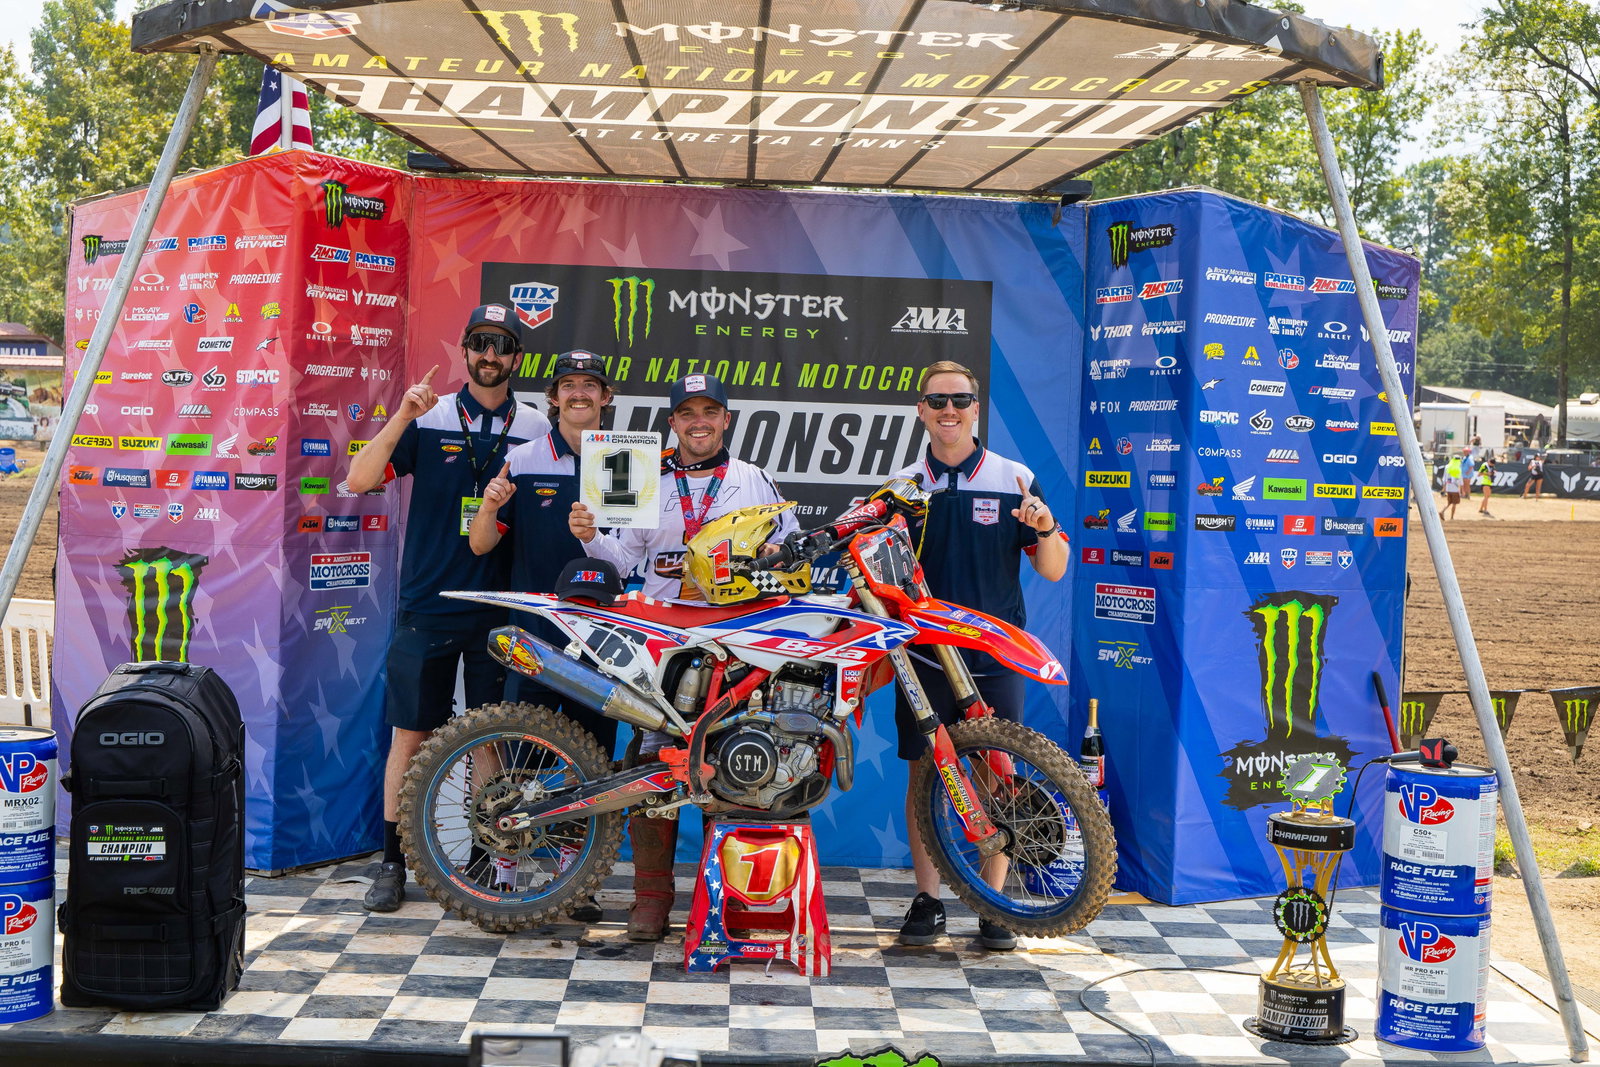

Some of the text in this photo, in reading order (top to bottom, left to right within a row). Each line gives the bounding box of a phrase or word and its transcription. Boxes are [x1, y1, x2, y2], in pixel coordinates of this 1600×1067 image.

[612, 20, 1021, 50] MONSTER
[679, 45, 954, 60] ENERGY
[271, 53, 1272, 95] AMATEUR NATIONAL MOTOCROSS
[568, 127, 947, 151] AT LORETTA LYNN'S
[344, 195, 384, 213] MONSTER
[1130, 226, 1173, 242] MONSTER
[188, 236, 226, 246] PARTS
[1136, 240, 1165, 248] ENERGY
[312, 245, 350, 262] AMSOIL
[355, 253, 395, 267] PARTS
[229, 273, 282, 285] PROGRESSIVE
[1265, 273, 1305, 285] PARTS
[1096, 286, 1133, 298] PARTS
[1140, 280, 1183, 298] AMSOIL
[1265, 281, 1305, 291] UNLIMITED
[1311, 279, 1356, 294] AMSOIL
[511, 286, 557, 299] MX
[365, 293, 398, 307] THOR
[668, 286, 848, 321] MONSTER
[891, 306, 969, 331] AMA
[1204, 313, 1257, 328] PROGRESSIVE
[1278, 317, 1308, 328] campers
[695, 324, 820, 340] ENERGY
[1104, 324, 1133, 339] THOR
[1318, 332, 1351, 341] OAKLEY
[306, 334, 337, 342] OAKLEY
[199, 340, 231, 349] COMETIC
[121, 372, 153, 380] Surefoot
[305, 364, 355, 378] PROGRESSIVE
[372, 368, 392, 381] FOX
[645, 357, 781, 387] NATIONAL
[1250, 383, 1284, 394] COMETIC
[121, 407, 153, 416] OGIO
[1100, 401, 1120, 413] FOX
[1128, 400, 1179, 412] PROGRESSIVE
[234, 408, 279, 417] COMPASS
[1200, 410, 1239, 425] STACYC
[1285, 416, 1313, 428] GUTS
[1325, 420, 1359, 429] Surefoot
[122, 440, 159, 448] SUZUKI
[588, 434, 609, 442] AMA
[171, 441, 208, 450] Kawasaki
[308, 441, 328, 451] YAMAHA
[1198, 447, 1242, 458] COMPASS
[1323, 453, 1358, 464] OGIO
[1386, 456, 1406, 467] PSD
[74, 471, 93, 480] KTM
[200, 475, 227, 484] YAMAHA
[236, 477, 267, 485] TRIUMPH
[602, 448, 638, 507] 1
[1088, 474, 1127, 485] SUZUKI
[1155, 475, 1176, 484] YAMAHA
[1268, 485, 1302, 494] Kawasaki
[1317, 486, 1353, 496] SUZUKI
[1363, 488, 1403, 498] ACERBIS
[759, 504, 788, 516] FLY
[816, 506, 828, 516] BY
[1197, 517, 1227, 526] TRIUMPH
[1252, 519, 1275, 527] YAMAHA
[1332, 521, 1364, 531] Husqvarna
[1379, 522, 1397, 532] KTM
[707, 539, 733, 585] 1
[1153, 556, 1169, 565] KTM
[311, 563, 370, 579] MOTOCROSS
[570, 570, 606, 584] AMA
[719, 586, 747, 596] FLY
[1114, 587, 1137, 595] AMERICAN
[1096, 595, 1155, 612] MOTOCROSS
[344, 617, 367, 626] NEXT
[776, 639, 868, 661] Beta
[1131, 655, 1152, 664] NEXT
[100, 732, 165, 746] OGIO
[735, 754, 762, 772] STM
[23, 772, 49, 789] Racing
[948, 763, 975, 812] BRIDGESTONE
[4, 797, 39, 808] MRX02
[1399, 783, 1438, 825] VP
[1422, 808, 1455, 821] Racing
[1274, 829, 1328, 843] CHAMPION
[1413, 828, 1432, 836] C50+
[25, 832, 50, 845] FUEL
[101, 843, 153, 854] CHAMPION
[739, 847, 781, 895] 1
[1390, 861, 1458, 879] RACE FUEL
[8, 913, 38, 932] Racing
[4, 940, 20, 948] PRO
[1399, 921, 1441, 962] VP
[1424, 946, 1457, 960] Racing
[12, 973, 42, 986] FUEL
[1389, 998, 1460, 1016] RACE FUEL
